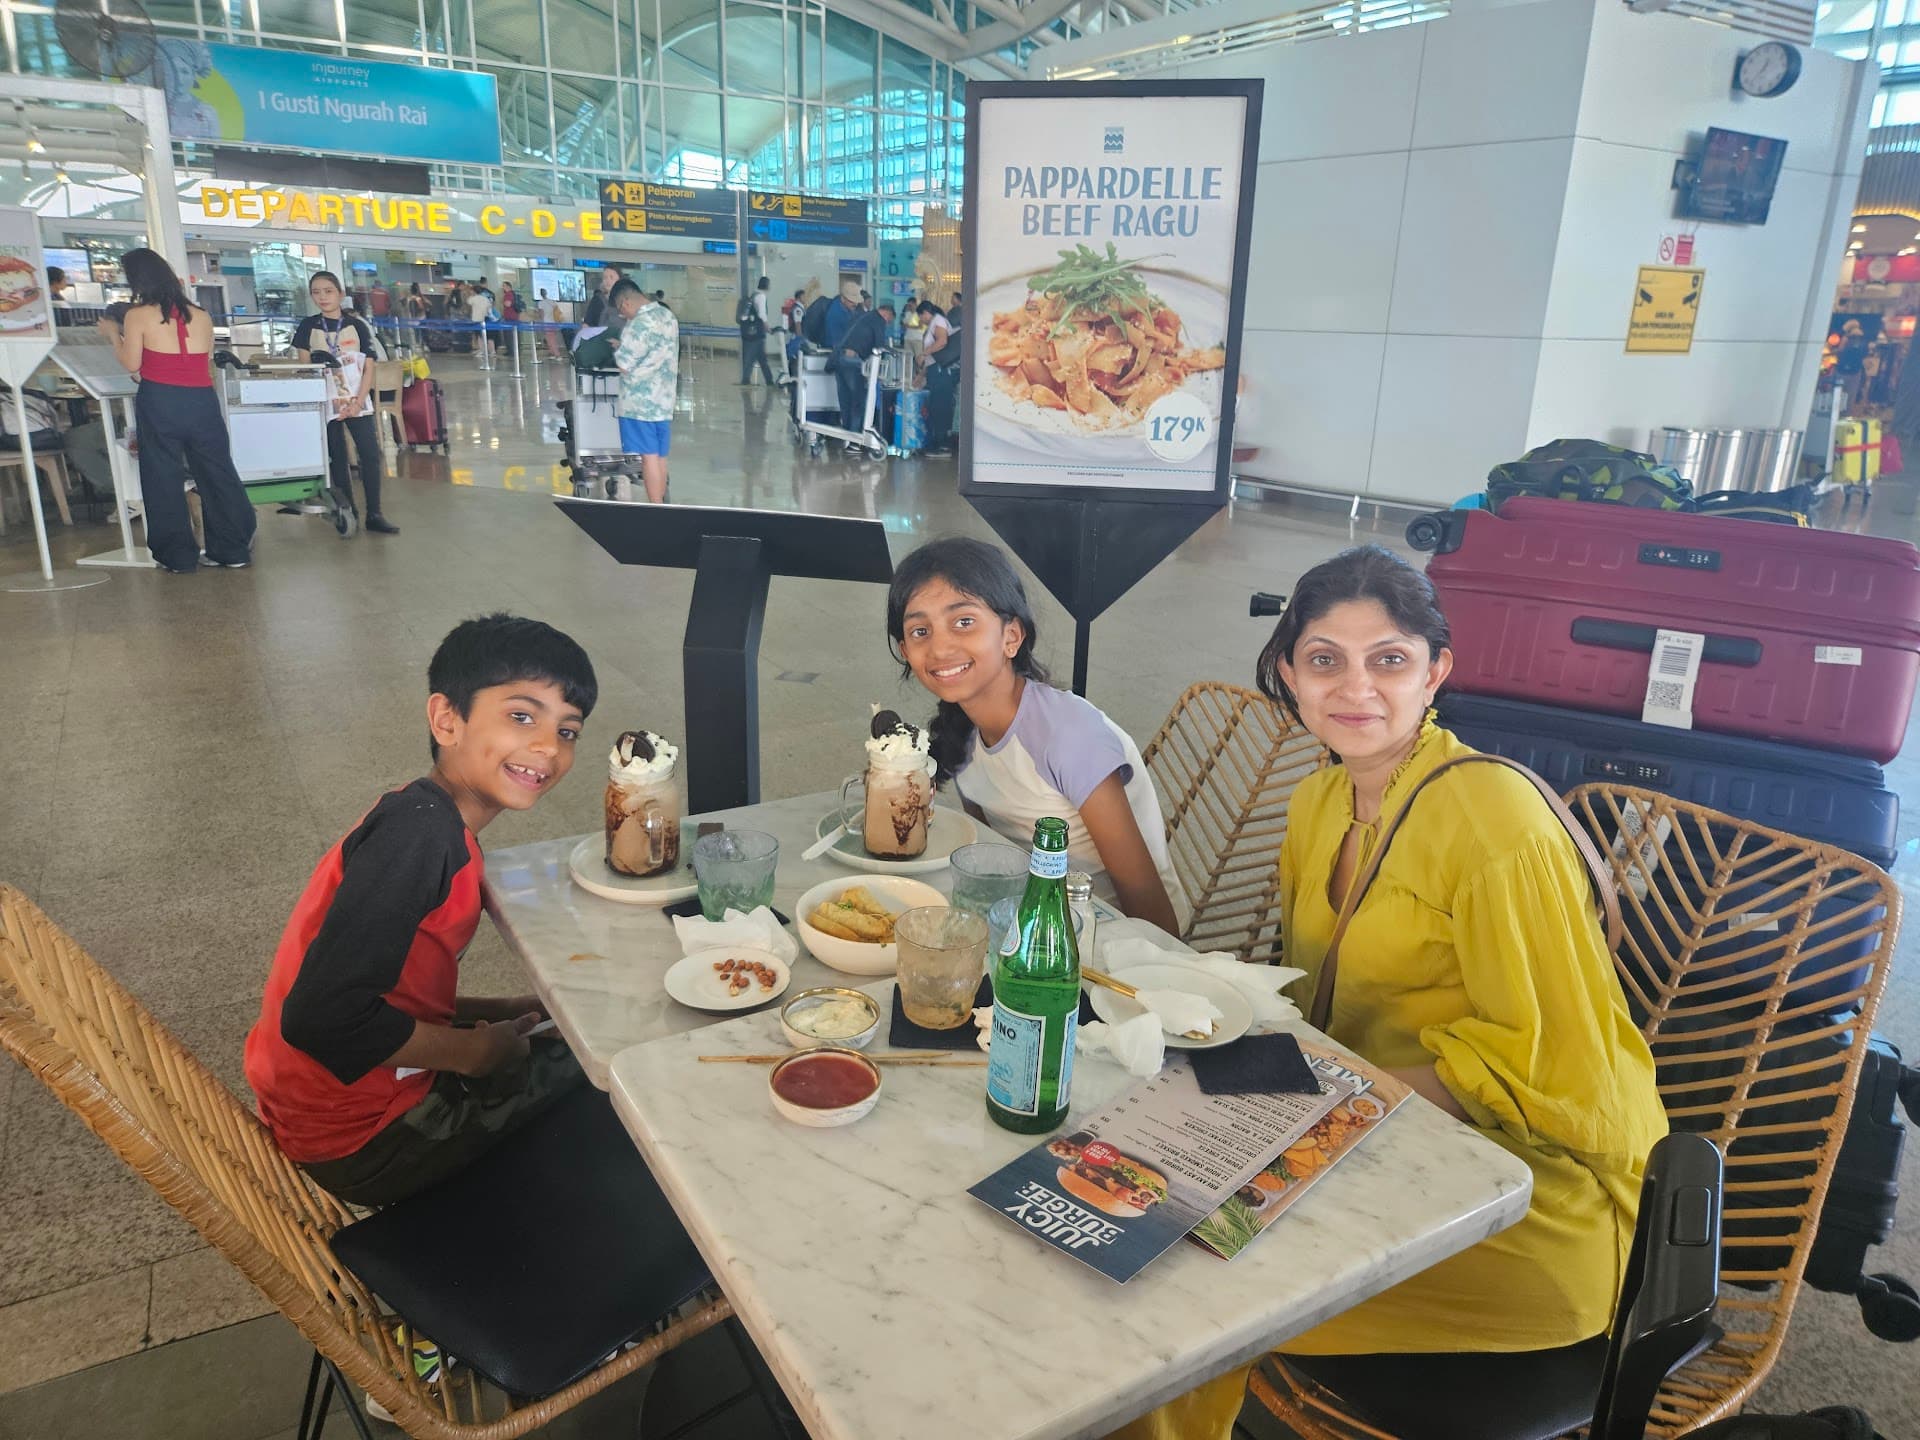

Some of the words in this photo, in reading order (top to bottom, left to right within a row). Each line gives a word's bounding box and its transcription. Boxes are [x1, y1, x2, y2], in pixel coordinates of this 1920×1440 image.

[271, 94, 320, 115] Gusti
[325, 96, 395, 124] Ngurah
[399, 103, 428, 126] Rai
[648, 186, 696, 199] Pelaporan
[1004, 166, 1223, 200] PAPPARDELLE
[201, 186, 452, 234] DEPARTURE
[1022, 204, 1102, 236] BEEF
[1112, 204, 1200, 237] RAGU
[1302, 1052, 1374, 1096] MEN
[1003, 1199, 1100, 1252] JUICY
[1015, 1182, 1120, 1243] BURGER
